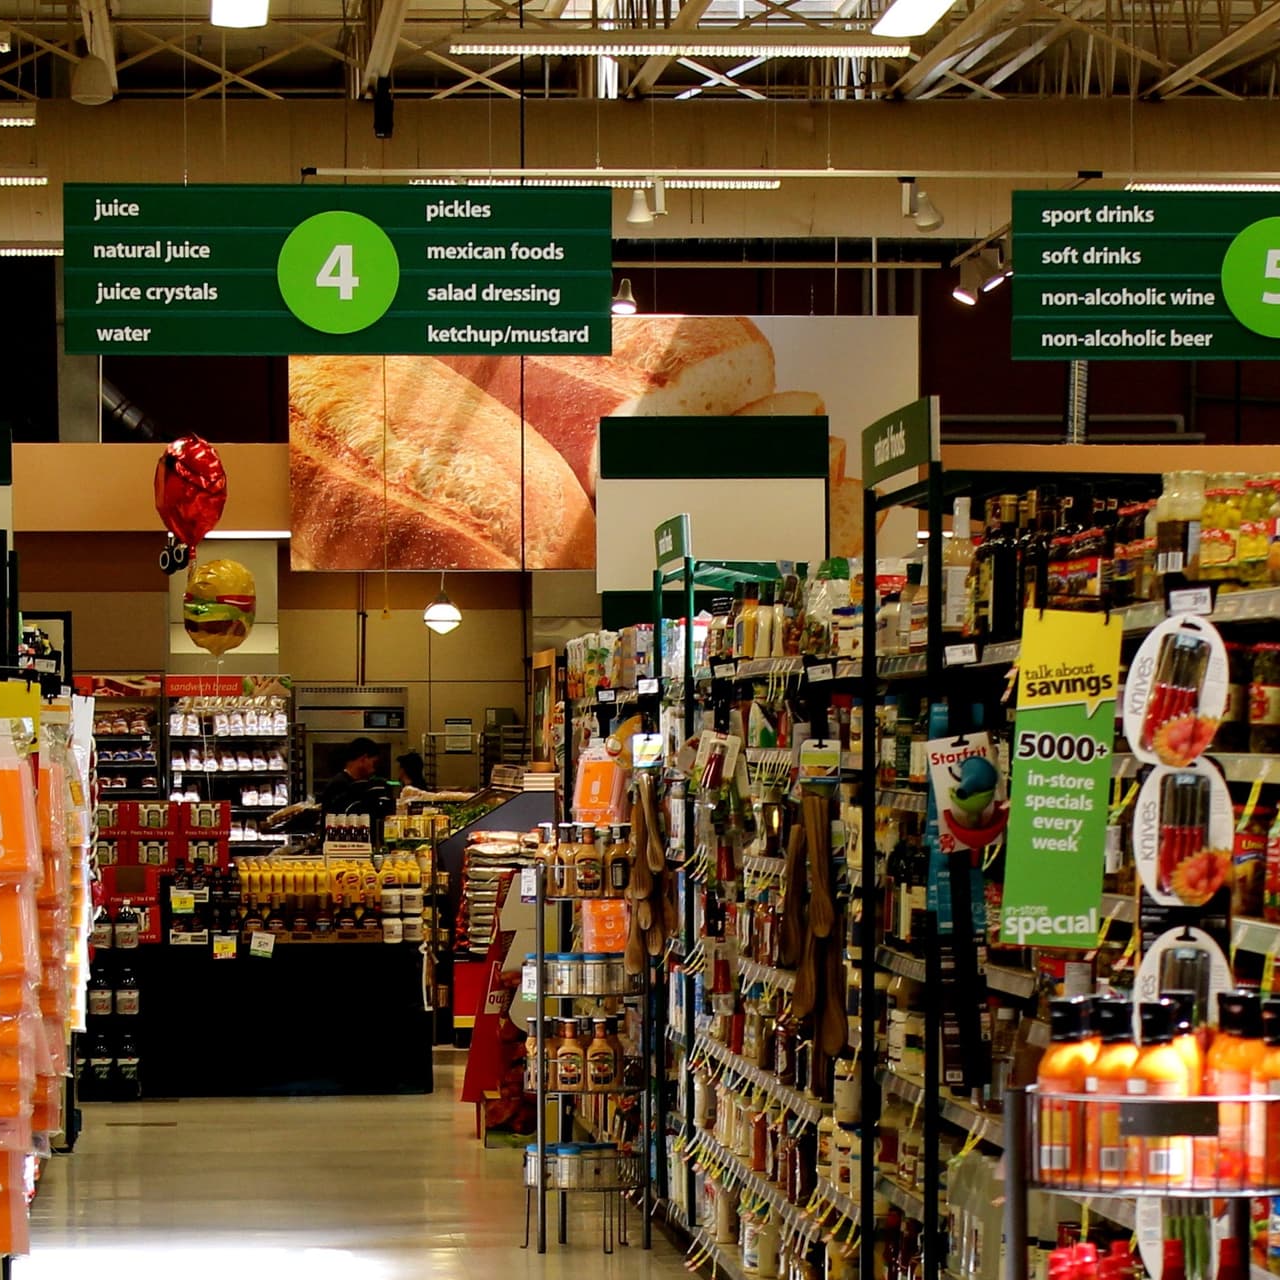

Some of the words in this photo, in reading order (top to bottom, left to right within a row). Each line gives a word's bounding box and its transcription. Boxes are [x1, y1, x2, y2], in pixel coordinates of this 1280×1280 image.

[93, 198, 140, 221] juice
[427, 200, 491, 221] pickles
[1042, 207, 1092, 227] sport
[1096, 205, 1154, 222] drinks
[93, 241, 161, 258] natural
[165, 241, 211, 262] juice
[427, 242, 506, 259] mexican
[510, 242, 565, 259] foods
[1042, 246, 1078, 264] soft
[1083, 246, 1141, 264] drinks
[315, 244, 359, 300] 4
[96, 283, 141, 305] juice
[145, 283, 218, 305] crystals
[428, 284, 476, 301] salad
[481, 284, 561, 305] dressing
[1042, 288, 1166, 306] non-alcoholic
[1170, 288, 1215, 305] wine
[96, 326, 151, 342] water
[427, 325, 589, 347] ketchup/mustard
[1042, 329, 1166, 347] non-alcoholic
[1170, 329, 1213, 347] beer
[1024, 665, 1054, 680] talk
[1056, 662, 1094, 678] about
[170, 681, 211, 692] sandwich
[213, 680, 238, 692] bread
[1026, 672, 1114, 698] savings
[1018, 733, 1109, 761] 5000+
[1028, 769, 1095, 790] in-store
[1024, 791, 1094, 812] specials
[1032, 816, 1083, 835] every
[1005, 907, 1097, 945] special
